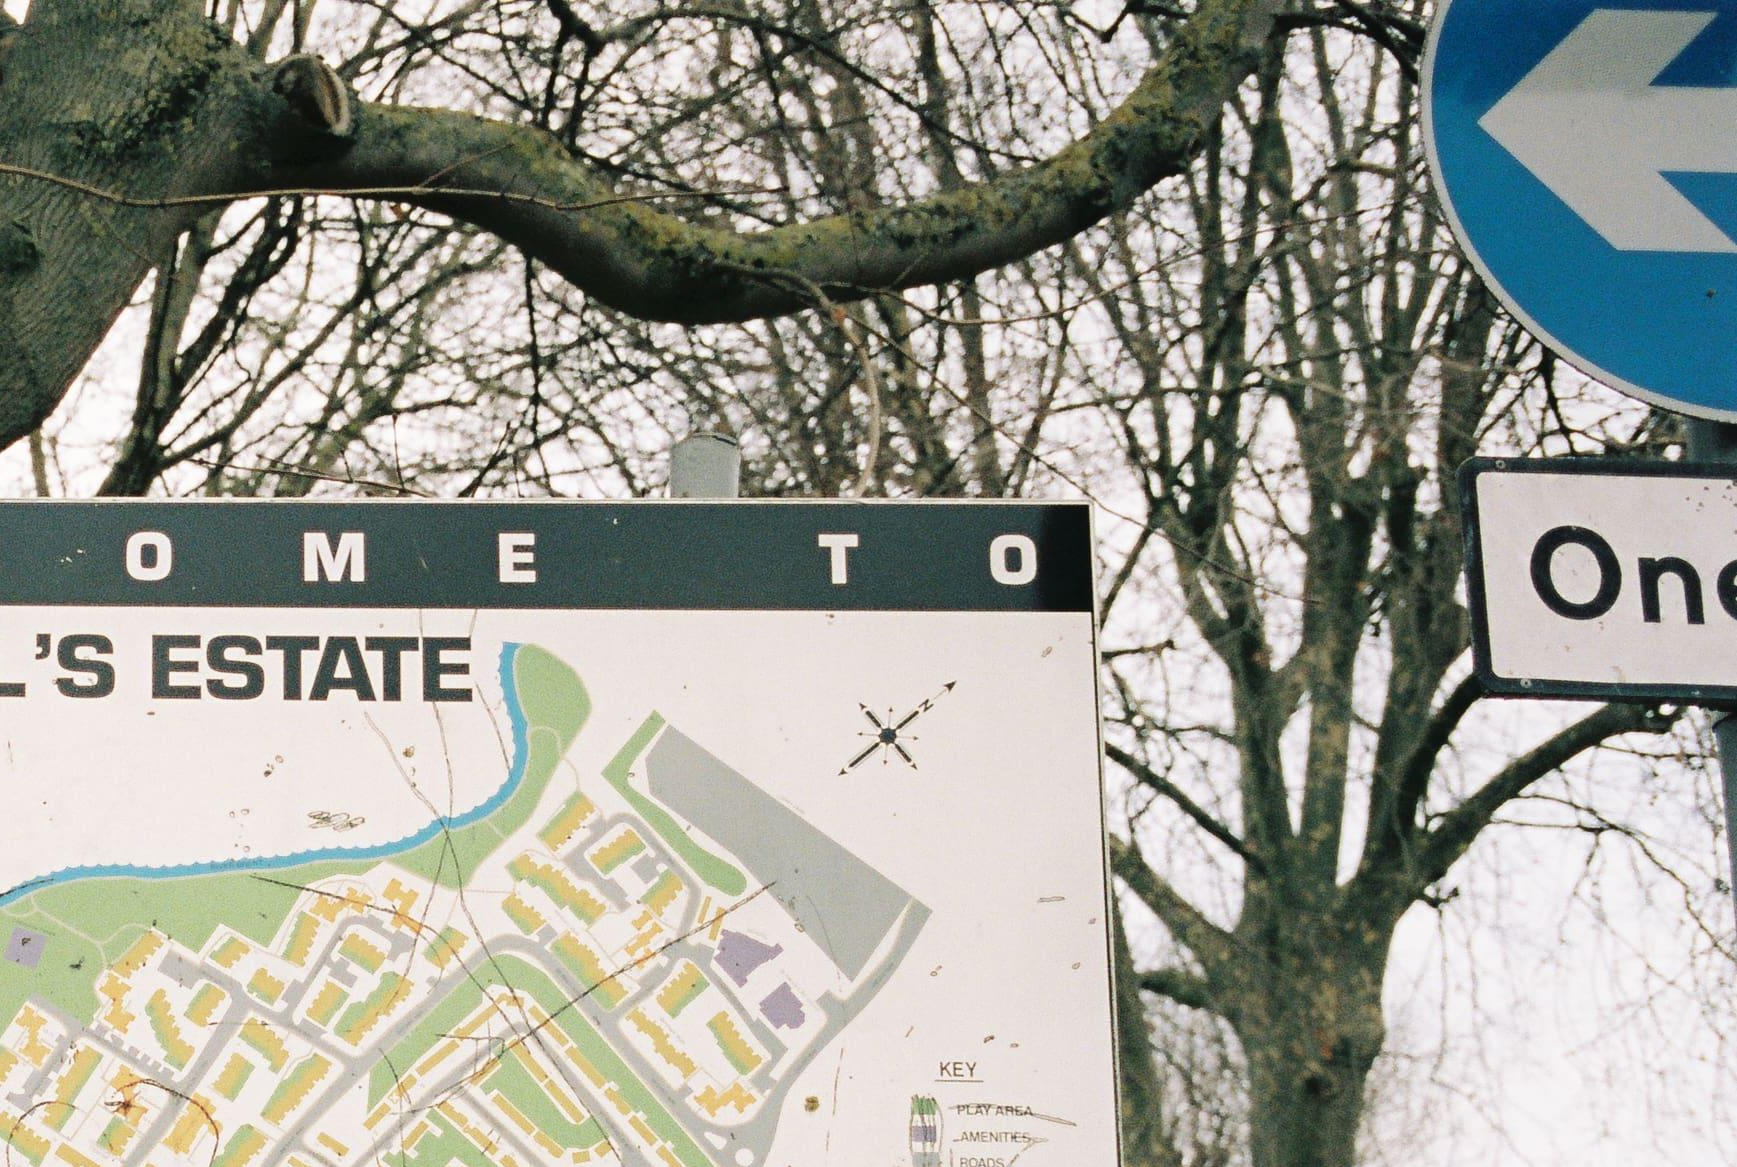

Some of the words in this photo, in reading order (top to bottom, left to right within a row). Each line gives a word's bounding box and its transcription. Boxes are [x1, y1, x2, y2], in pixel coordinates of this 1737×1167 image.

[818, 531, 1038, 586] TO
[1530, 525, 1737, 625] On
[152, 633, 473, 702] ESTATE
[918, 698, 934, 712] N
[939, 1062, 977, 1077] KEY
[956, 1104, 991, 1115] PLAY
[995, 1105, 1033, 1116] AREA
[961, 1131, 1031, 1143] AMENITIES
